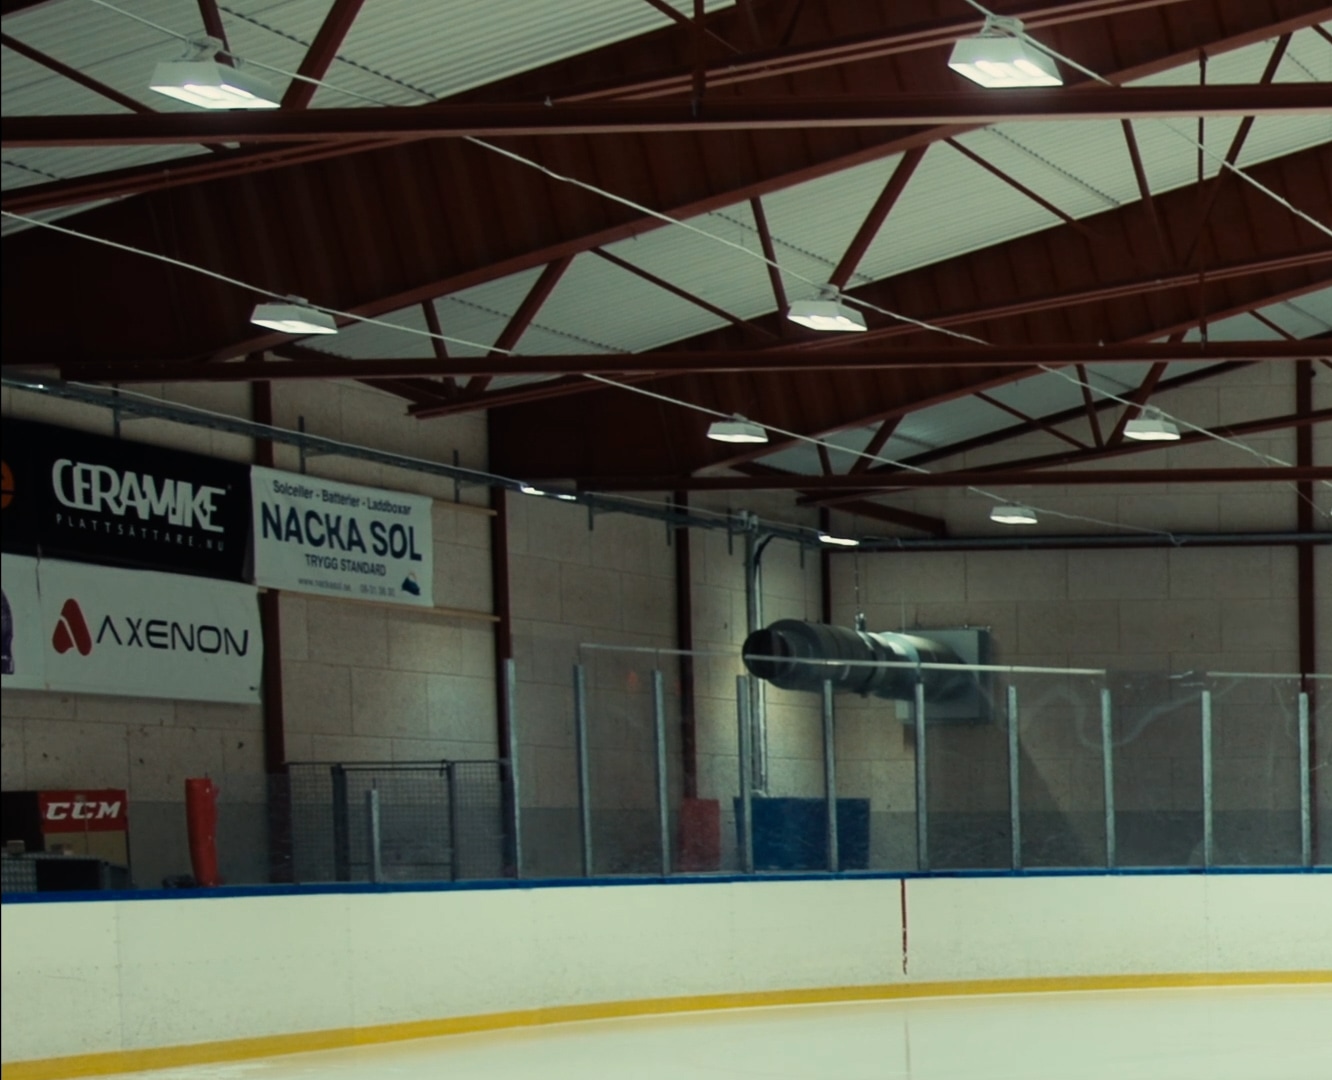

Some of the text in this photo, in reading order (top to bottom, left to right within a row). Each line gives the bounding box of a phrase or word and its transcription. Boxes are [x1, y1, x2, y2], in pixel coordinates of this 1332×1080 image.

[273, 480, 314, 499] Solceller
[322, 489, 361, 508] Batterier
[367, 497, 412, 515] Laddboxar
[261, 501, 423, 562] NACKA SOL
[305, 553, 387, 577] TRYGG STANDARD
[96, 615, 249, 657] AXENON
[46, 801, 122, 820] CCM
